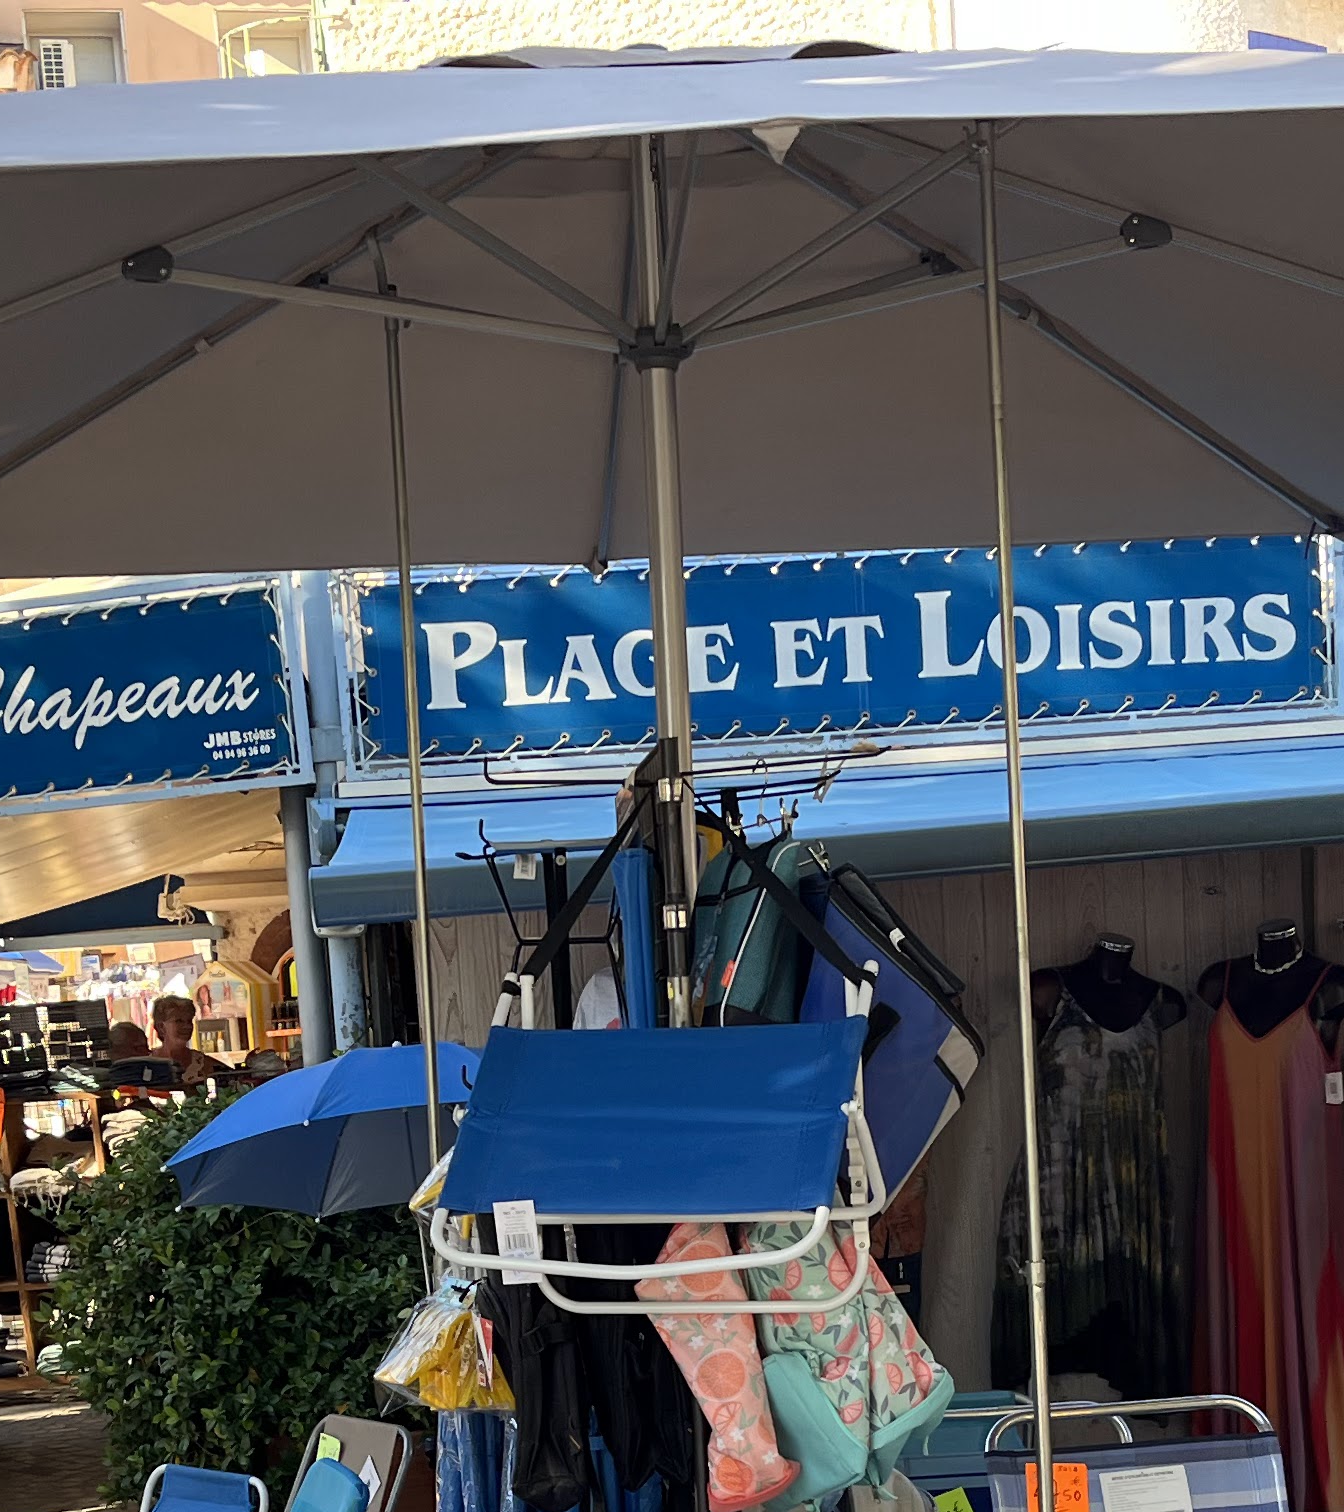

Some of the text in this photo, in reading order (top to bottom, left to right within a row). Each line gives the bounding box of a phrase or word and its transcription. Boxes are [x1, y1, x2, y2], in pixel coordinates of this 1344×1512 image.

[421, 590, 1299, 711] PLAGE ET LOISIRS
[203, 730, 242, 749] JMB
